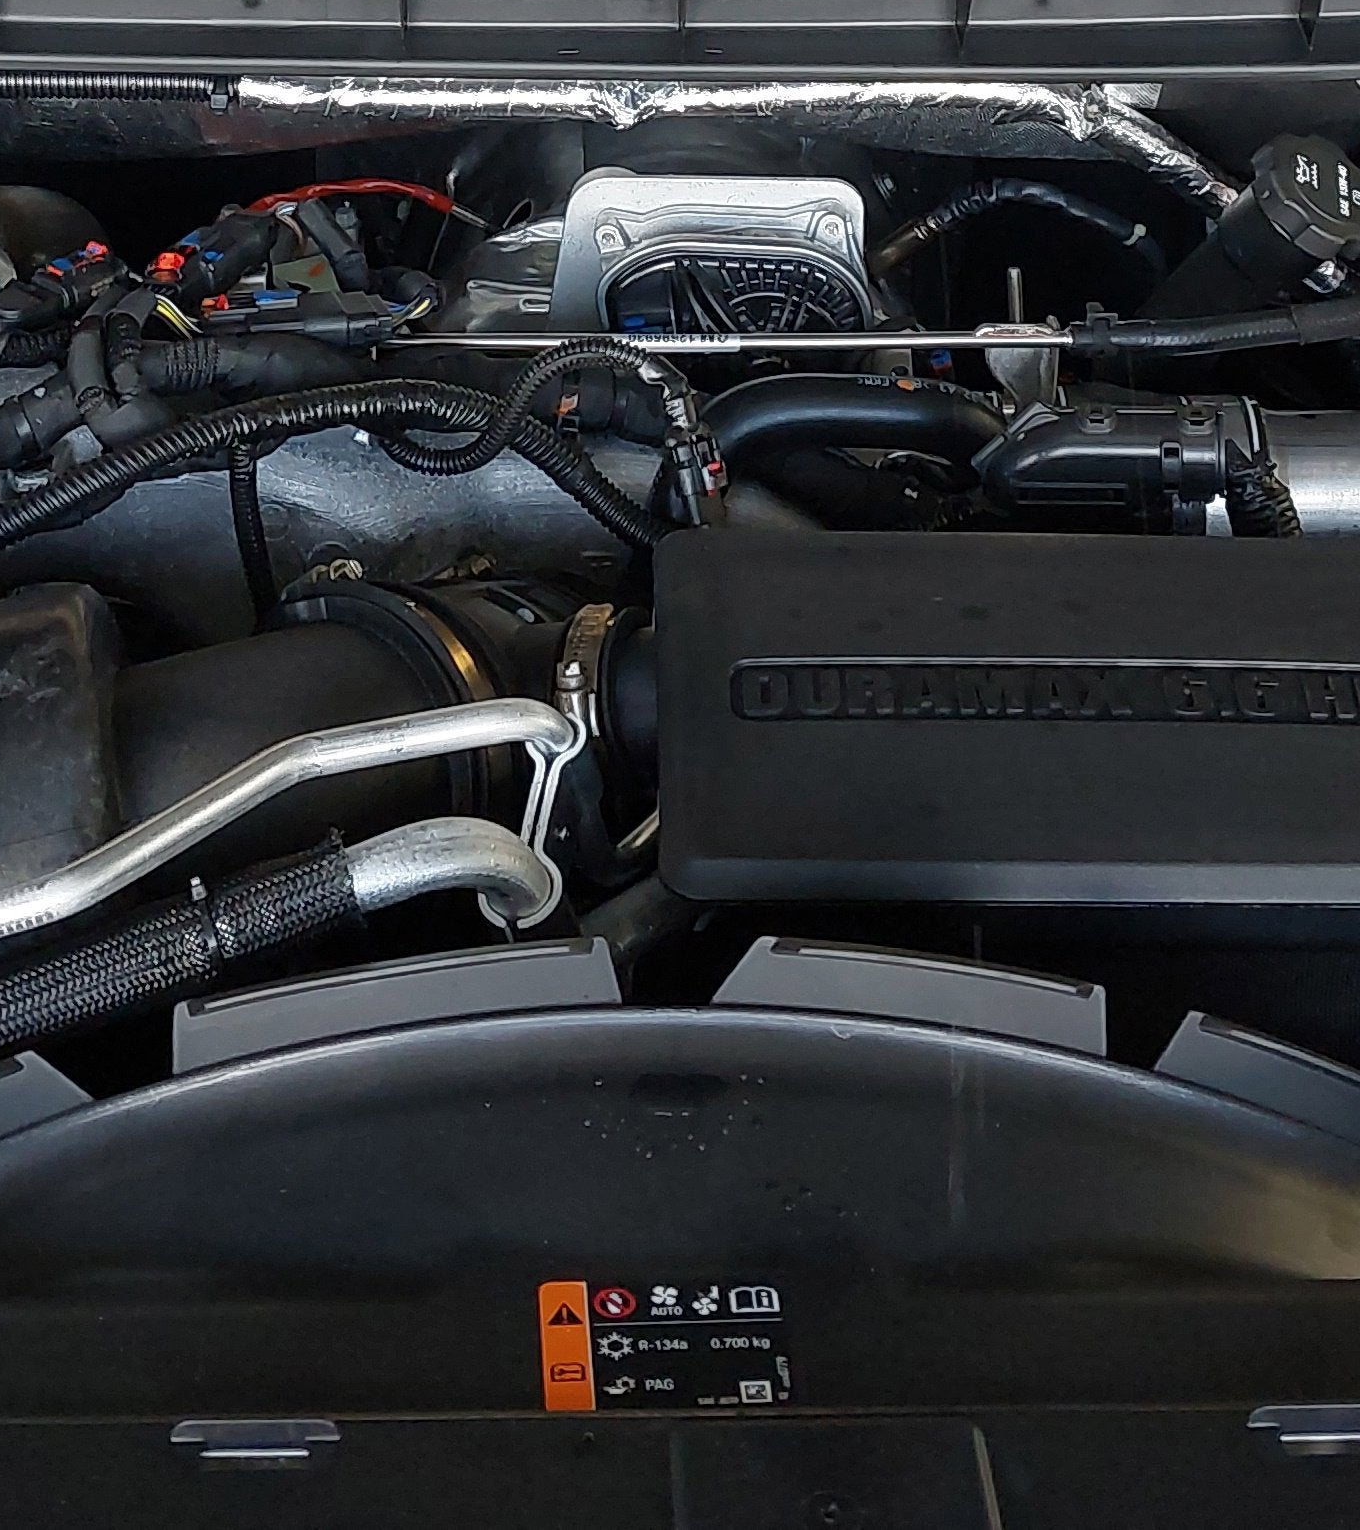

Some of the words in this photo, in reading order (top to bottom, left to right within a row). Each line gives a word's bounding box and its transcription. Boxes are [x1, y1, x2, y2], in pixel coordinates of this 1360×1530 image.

[740, 667, 1136, 719] DURAMAX
[1163, 673, 1283, 720] 6.6
[650, 1305, 684, 1317] AUTO
[638, 1338, 689, 1351] R-134a
[710, 1337, 750, 1350] 0.700
[752, 1336, 772, 1350] kg
[644, 1378, 676, 1392] PAG
